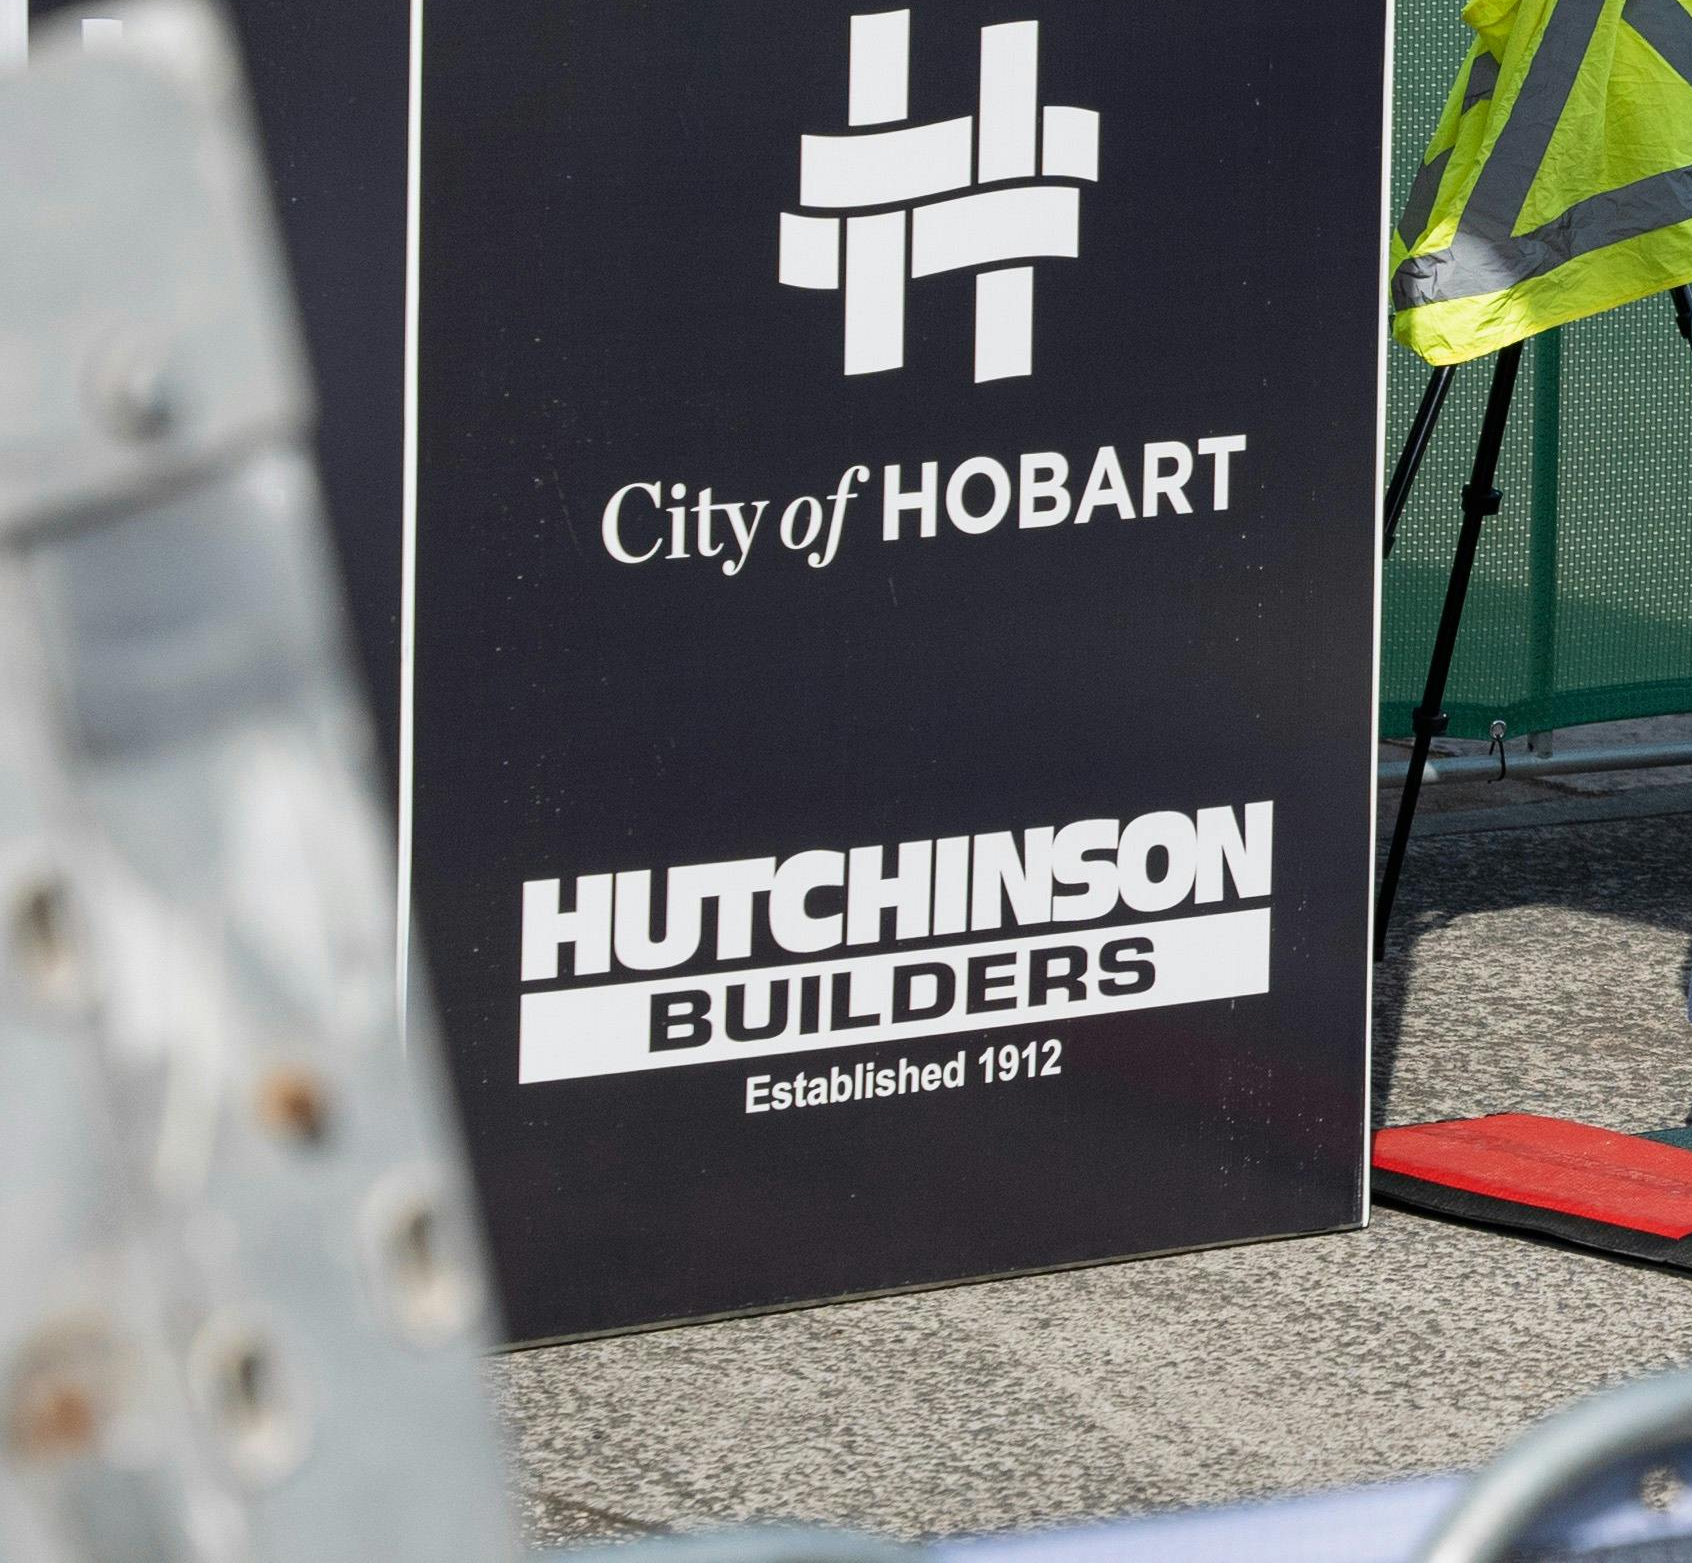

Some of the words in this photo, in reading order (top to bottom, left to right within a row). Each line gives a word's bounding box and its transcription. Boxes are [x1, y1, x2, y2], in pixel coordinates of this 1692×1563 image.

[601, 481, 769, 576] City
[779, 465, 870, 568] of
[883, 434, 1246, 541] HOBART
[521, 800, 1273, 982] HUTCHINSON
[647, 936, 1156, 1053] BUILDERS
[745, 1051, 966, 1114] Established
[977, 1039, 1063, 1085] 1912
